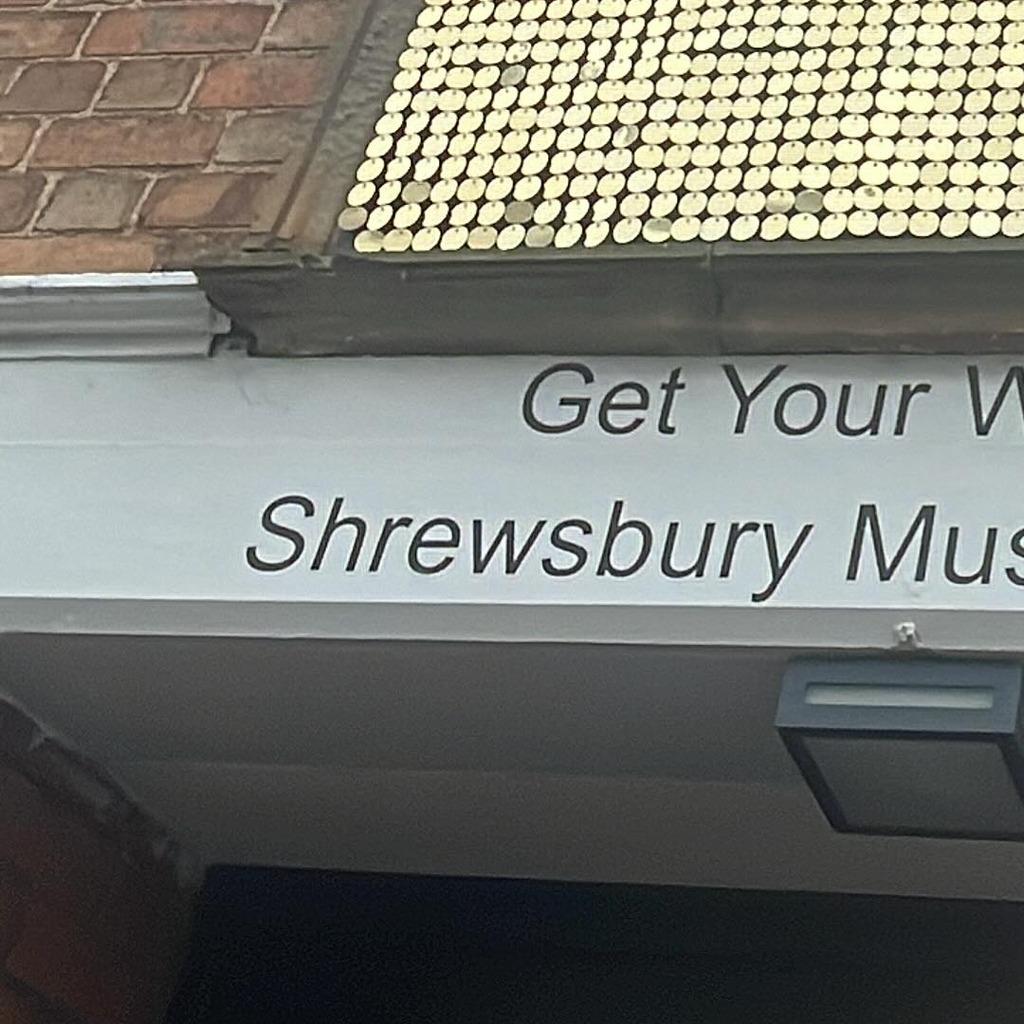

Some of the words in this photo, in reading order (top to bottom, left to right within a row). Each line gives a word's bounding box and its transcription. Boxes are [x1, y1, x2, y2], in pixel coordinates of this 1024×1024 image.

[522, 362, 685, 435] Get
[721, 364, 931, 437] Your
[246, 495, 813, 603] Shrewsbury
